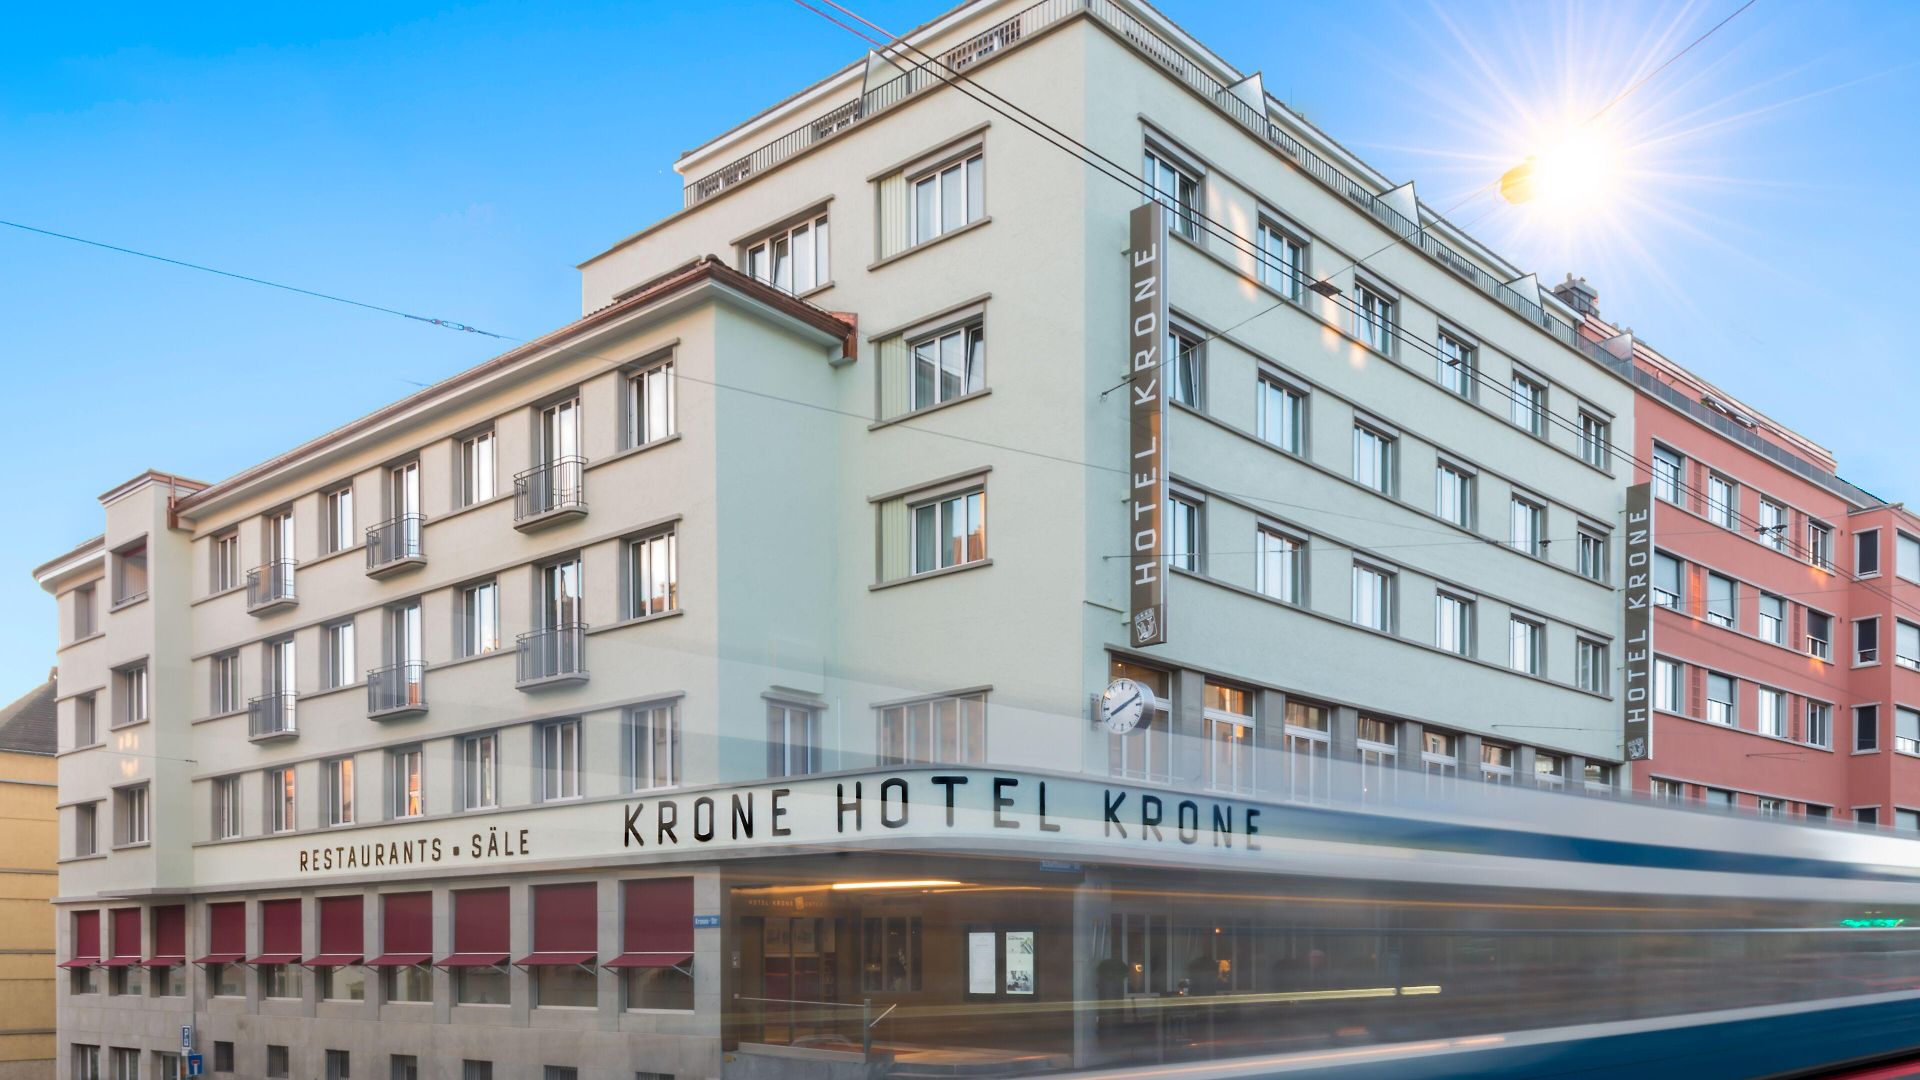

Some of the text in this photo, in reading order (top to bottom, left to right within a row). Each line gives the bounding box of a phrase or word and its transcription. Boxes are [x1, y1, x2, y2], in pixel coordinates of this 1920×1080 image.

[1134, 243, 1156, 585] HOTEL KRONE
[1628, 508, 1647, 722] HOTEL KRONE
[300, 827, 530, 872] RESTAURANTS SÄLE
[624, 776, 1261, 851] KRONE HOTEL KRONE
